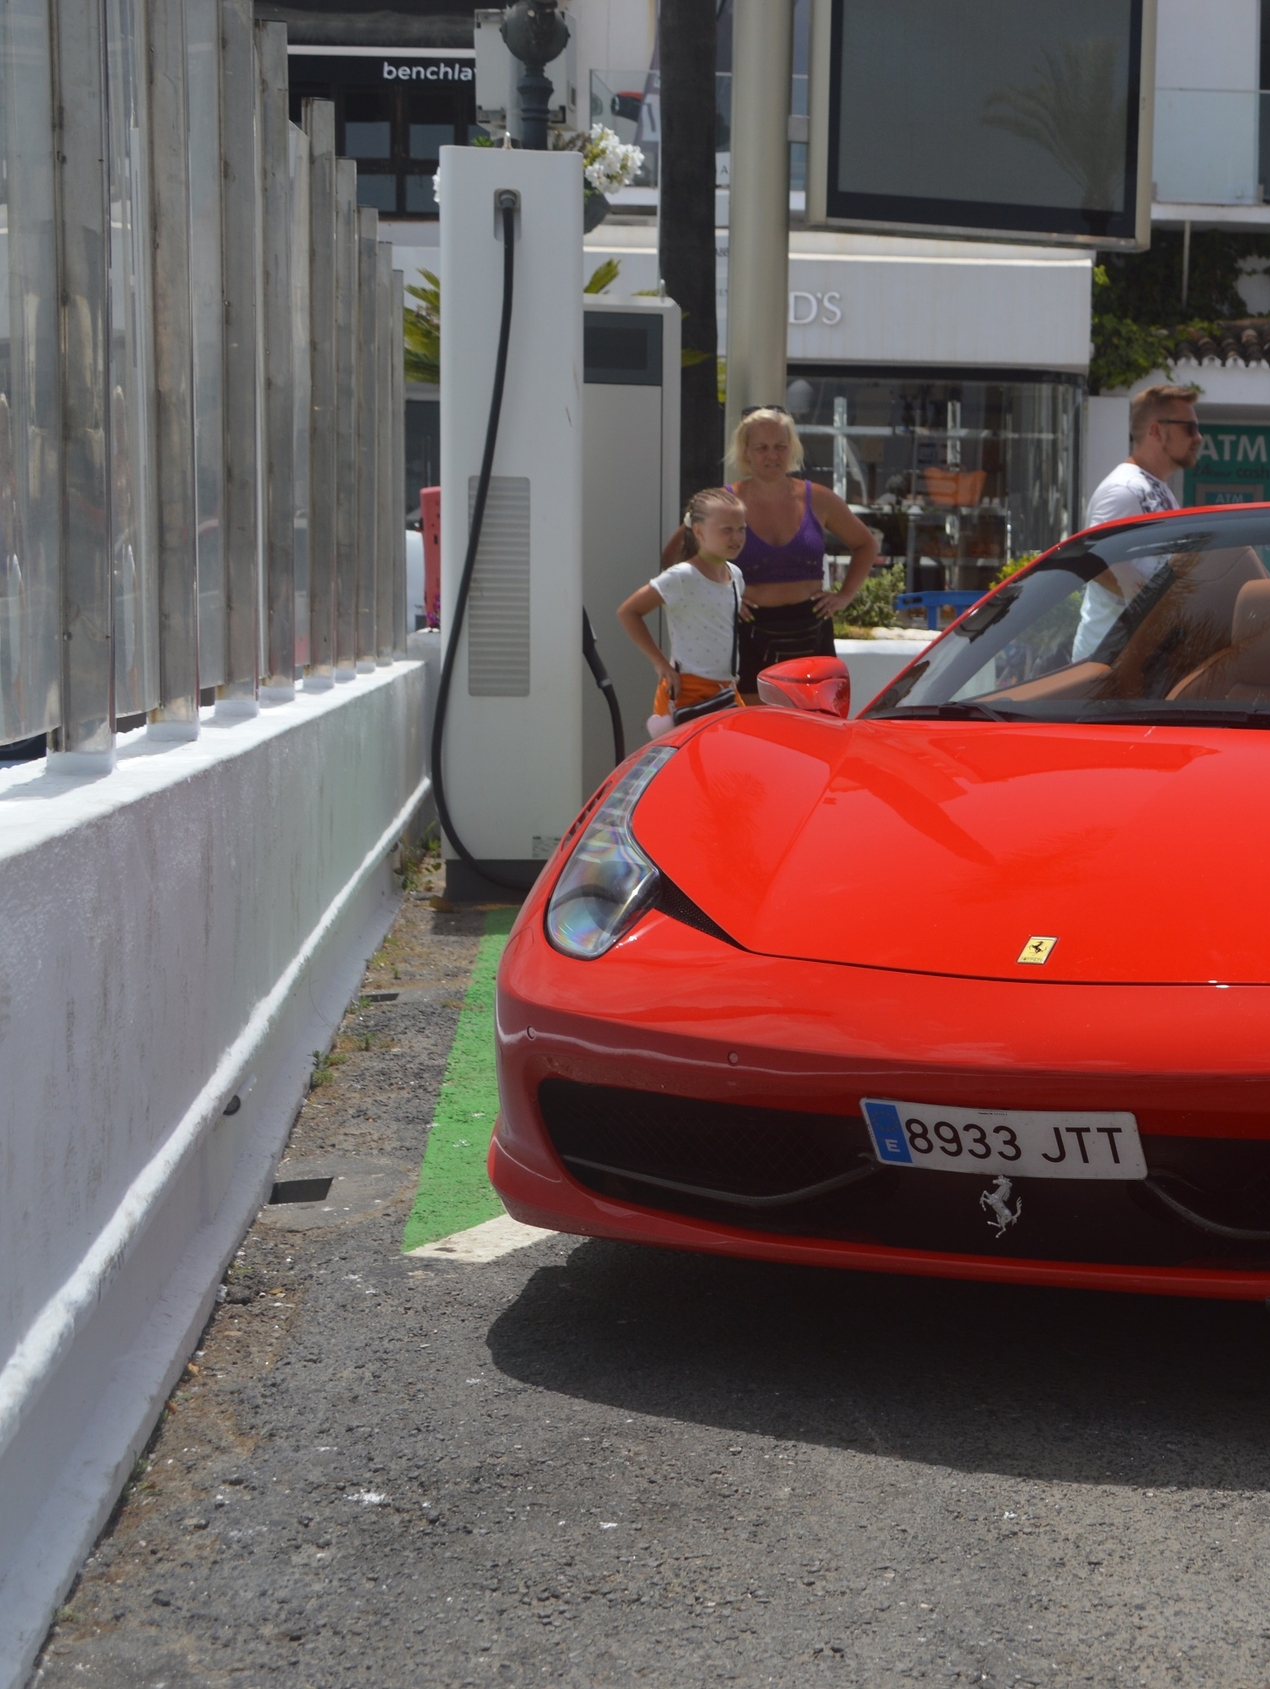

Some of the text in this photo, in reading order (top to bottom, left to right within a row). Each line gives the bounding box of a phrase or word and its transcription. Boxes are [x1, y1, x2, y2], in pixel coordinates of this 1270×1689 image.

[1196, 434, 1268, 462] ATM
[885, 1139, 900, 1152] E
[905, 1118, 1022, 1162] 8933
[1041, 1126, 1123, 1164] JTT
